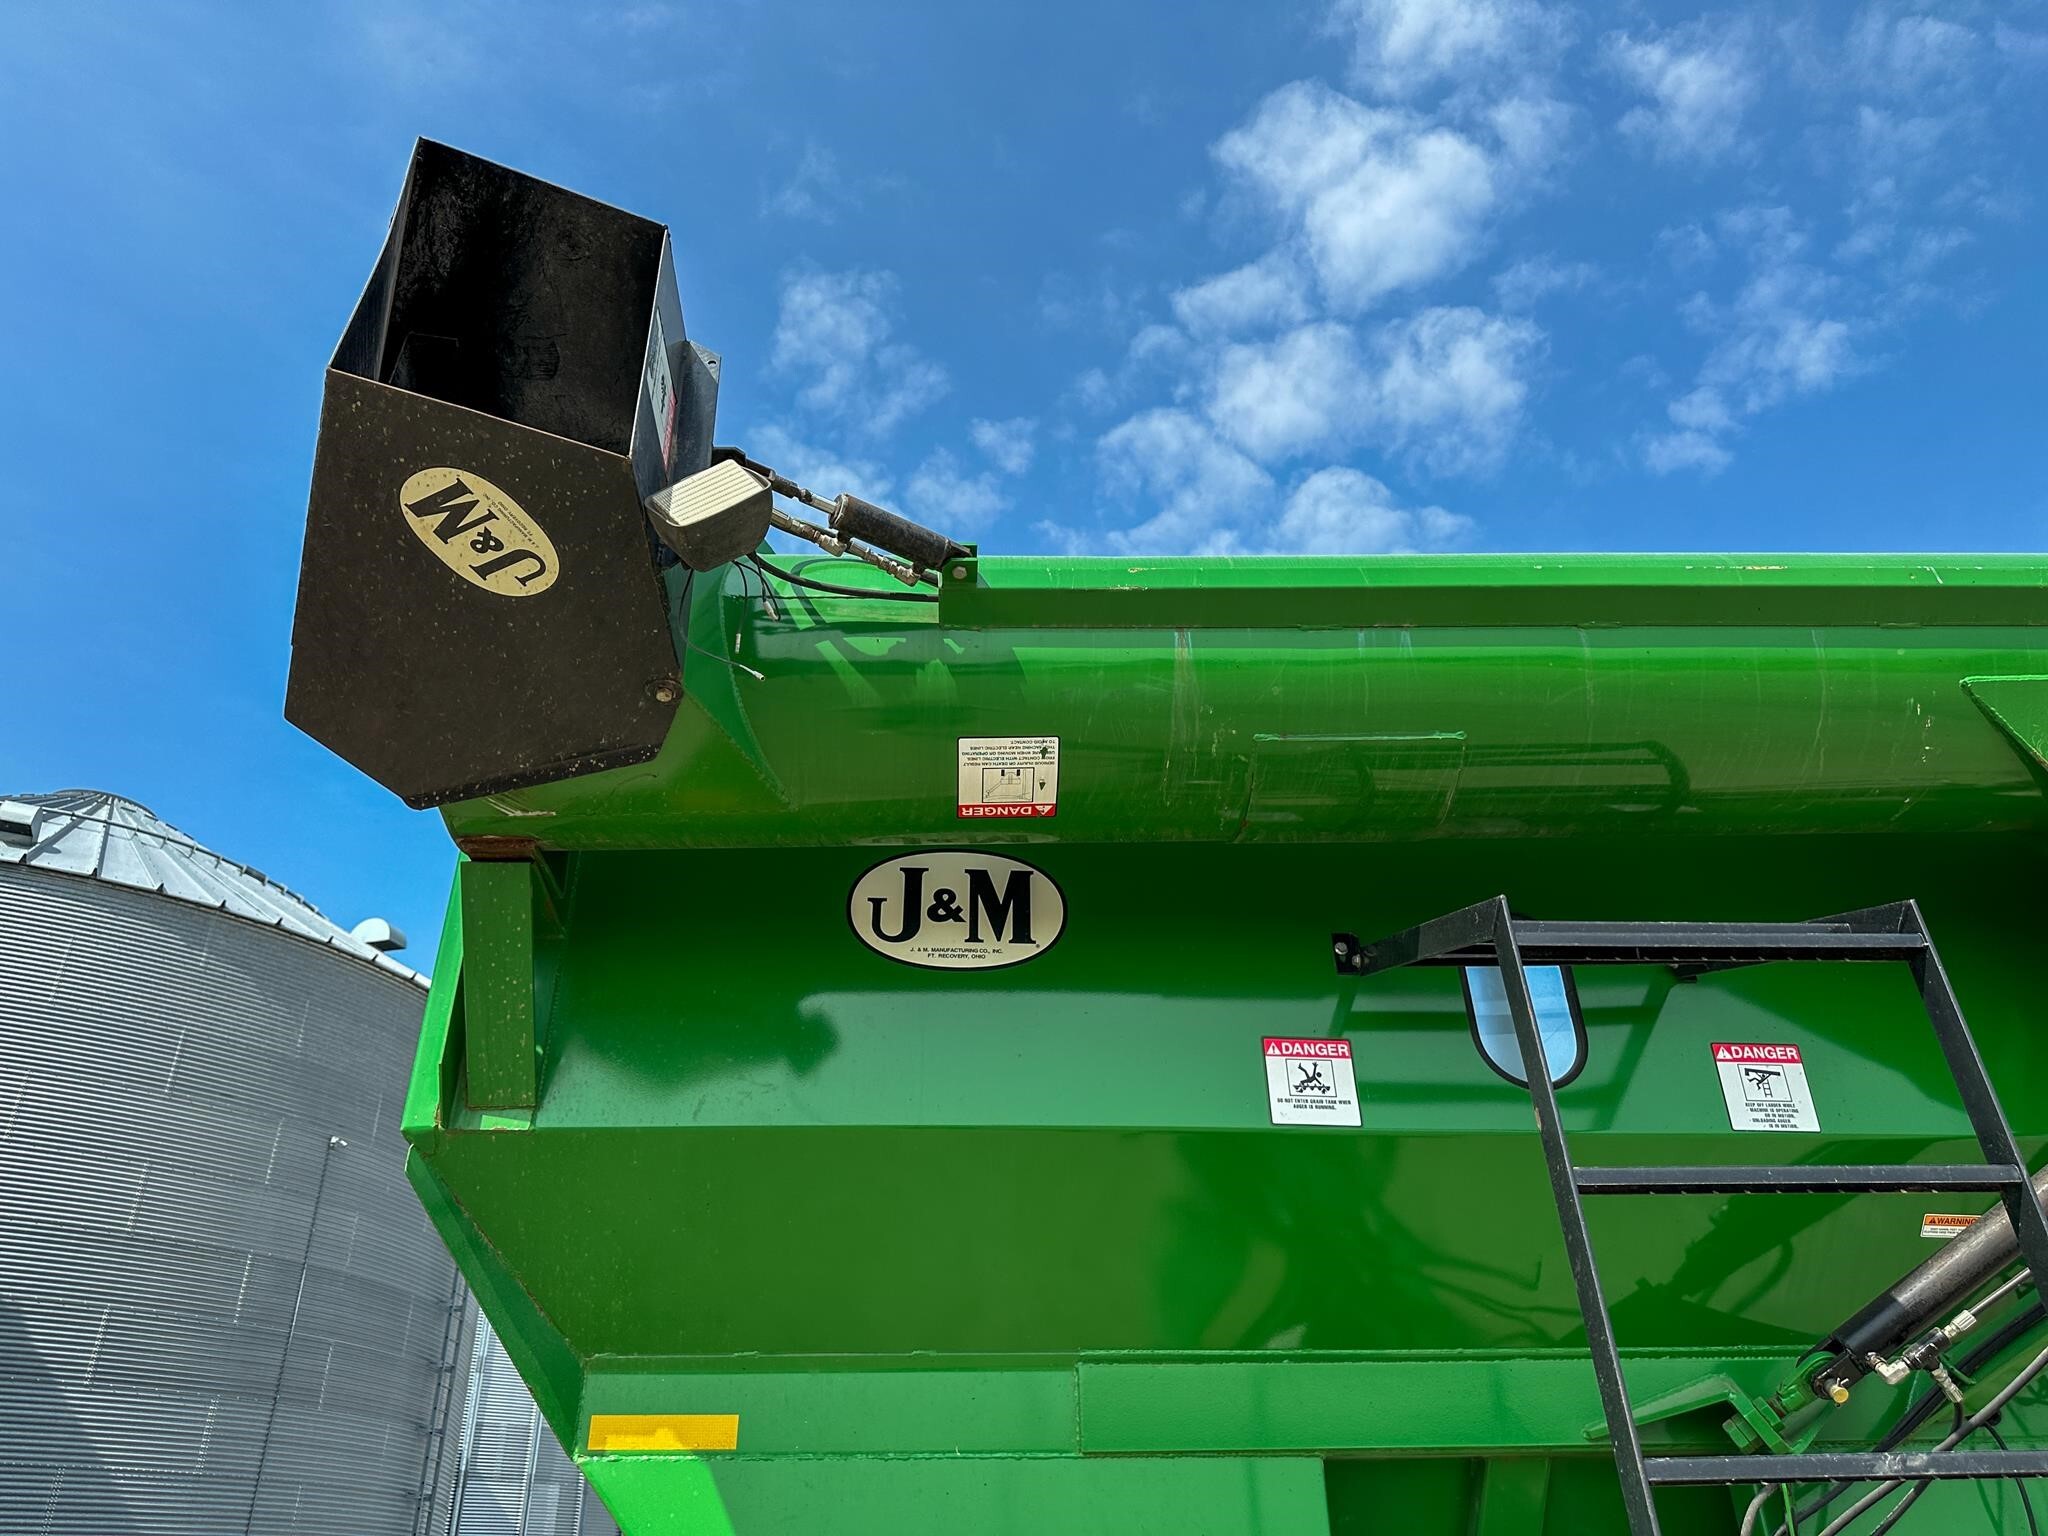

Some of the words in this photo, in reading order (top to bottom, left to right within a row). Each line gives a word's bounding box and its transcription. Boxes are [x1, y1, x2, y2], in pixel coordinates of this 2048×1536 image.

[404, 478, 546, 586] J&M
[962, 806, 1032, 816] DANGER
[868, 868, 1036, 944] J&M
[1282, 1042, 1349, 1056] DANGER
[1731, 1046, 1798, 1059] DANGER
